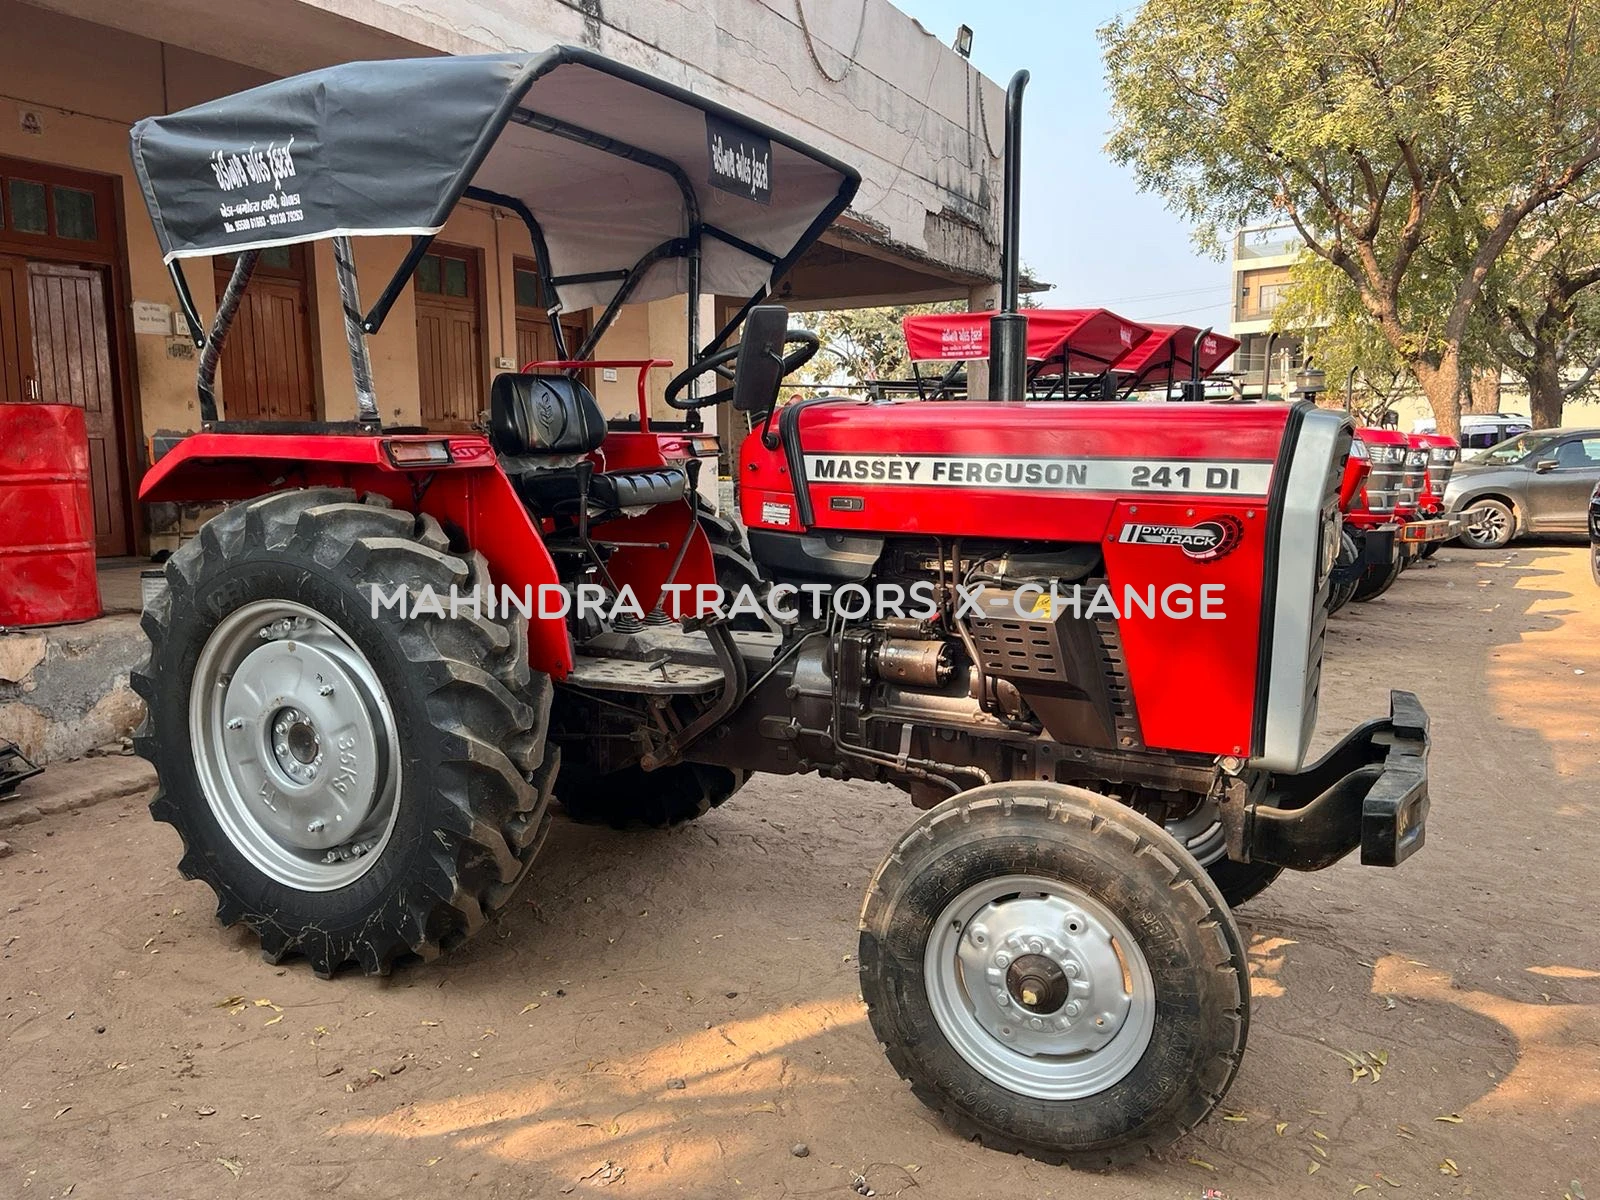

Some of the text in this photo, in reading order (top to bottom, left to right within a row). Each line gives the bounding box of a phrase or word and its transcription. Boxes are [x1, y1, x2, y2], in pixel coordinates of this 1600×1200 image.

[814, 459, 1240, 490] MASSEY FERGUSON 241 DI
[1142, 526, 1179, 536] DYNA
[1161, 534, 1218, 546] TRACK
